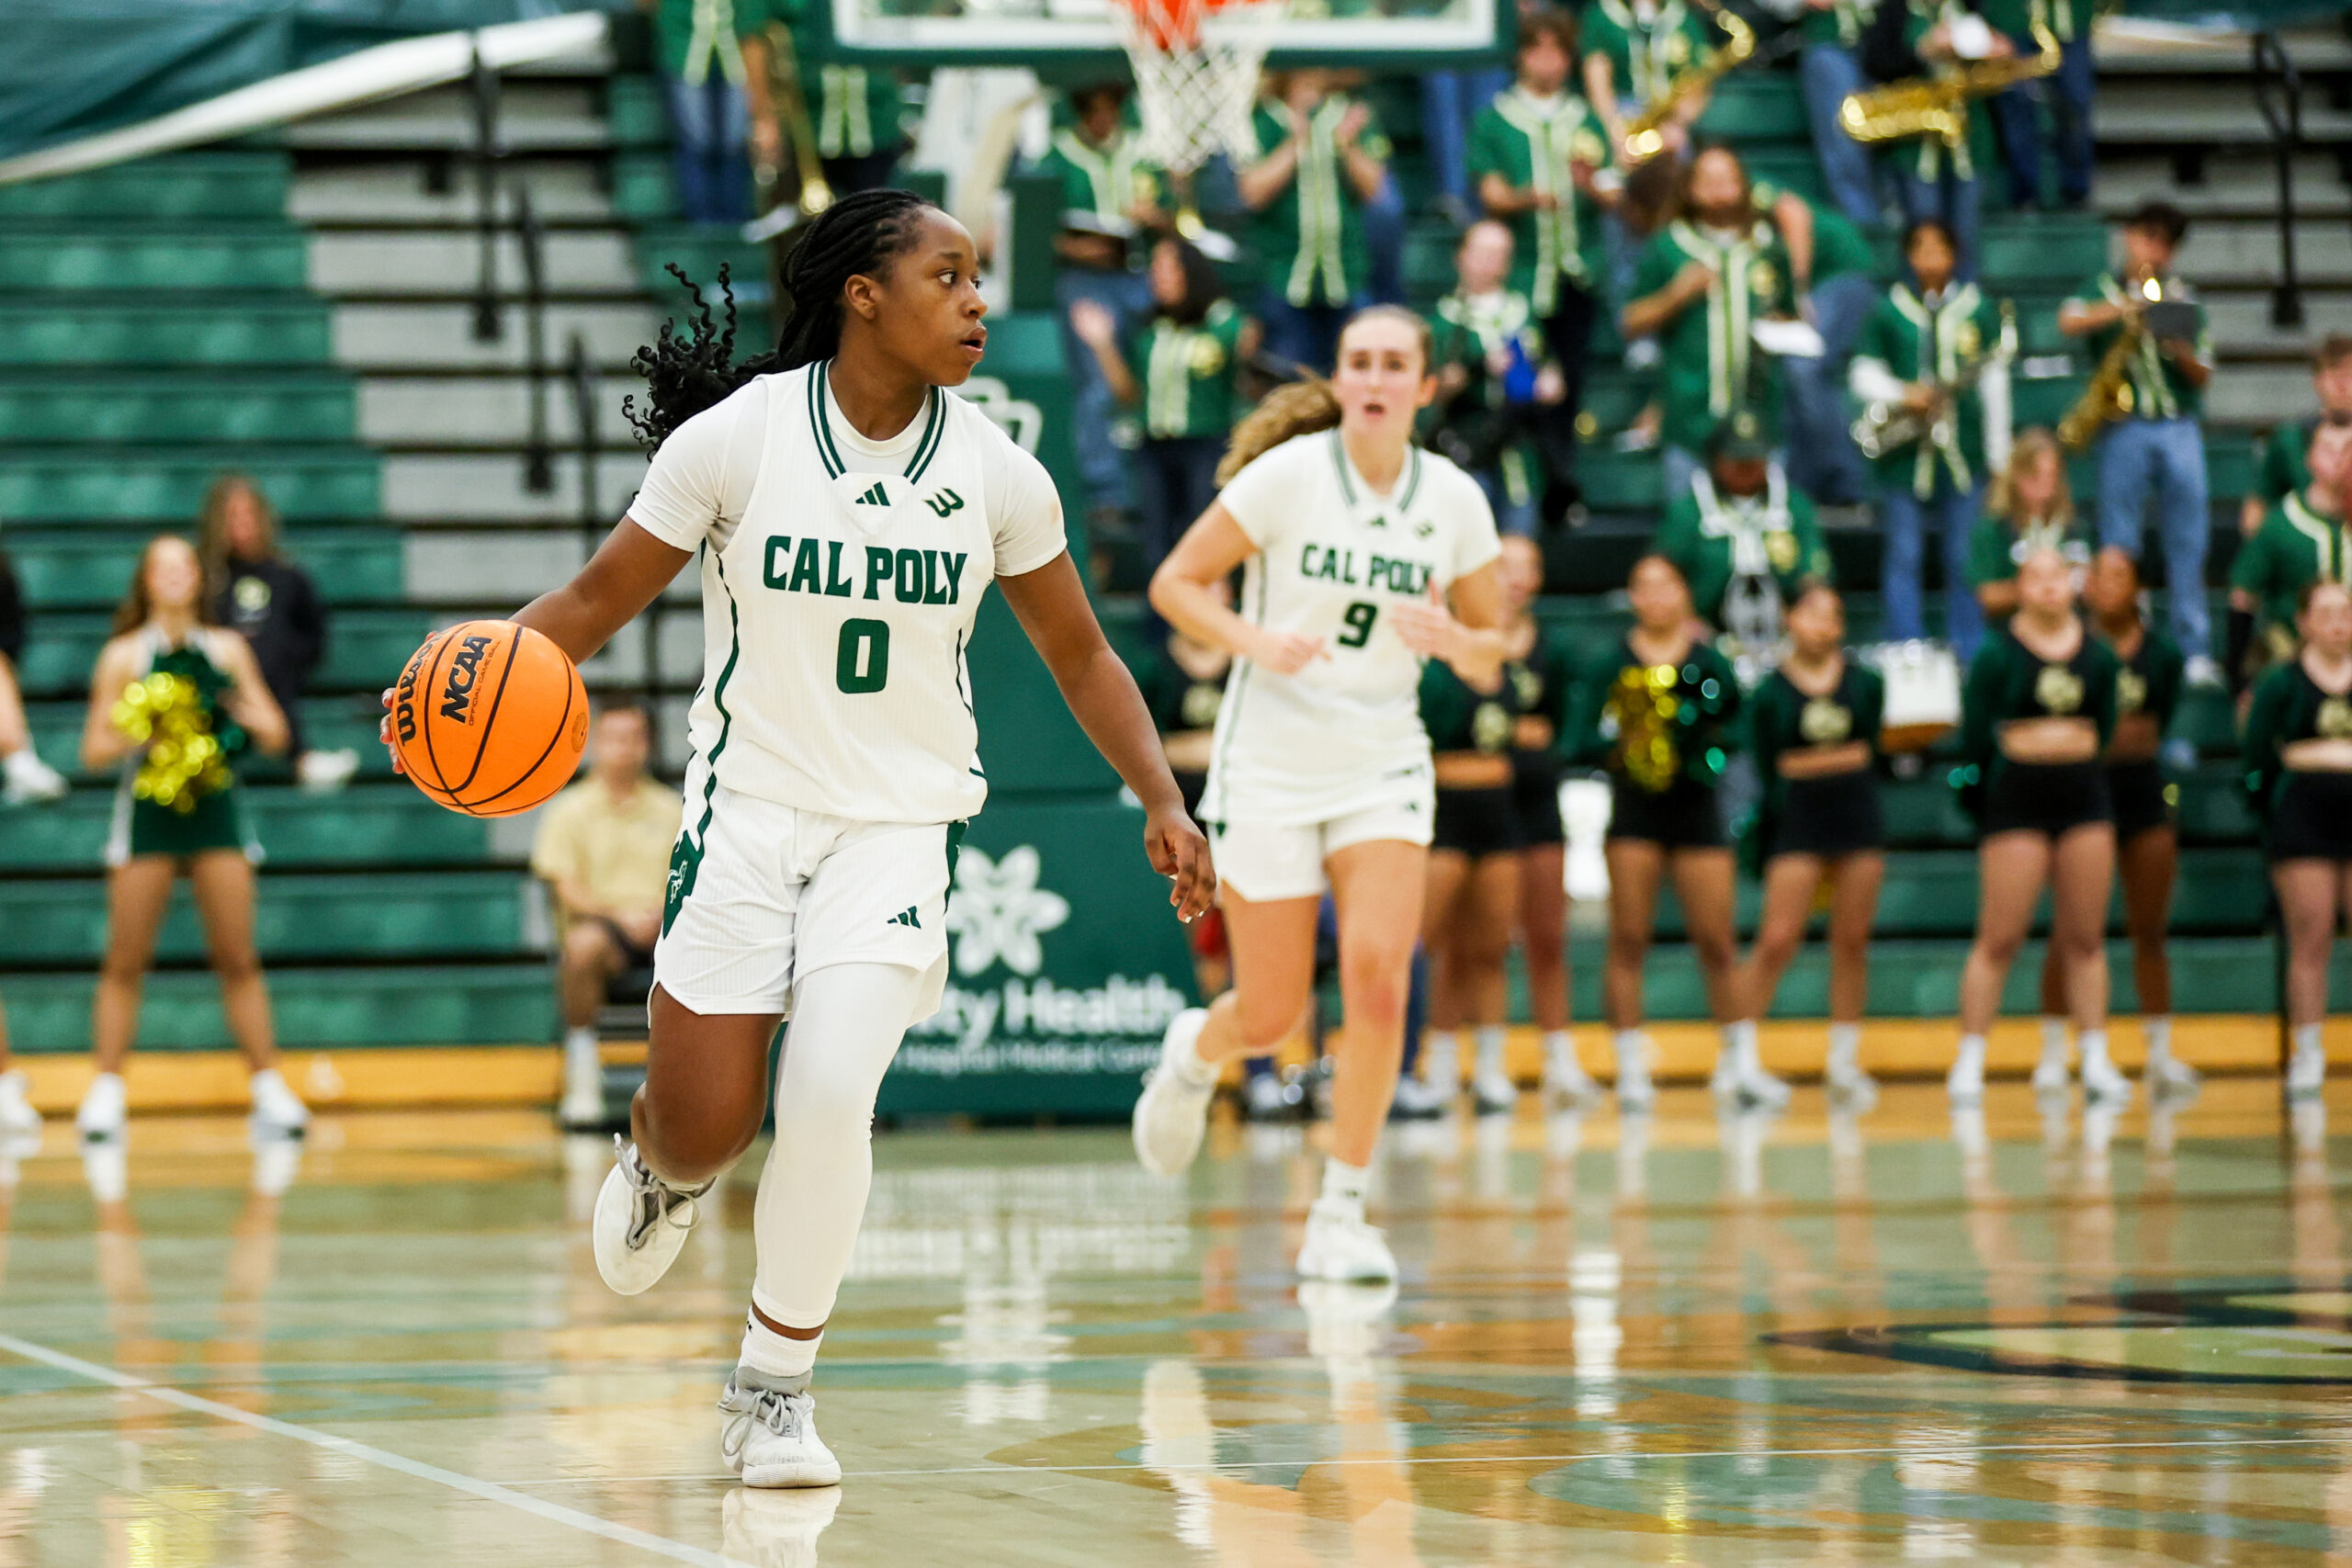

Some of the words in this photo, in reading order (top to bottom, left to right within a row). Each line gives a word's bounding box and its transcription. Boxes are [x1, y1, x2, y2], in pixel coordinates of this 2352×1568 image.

[763, 536, 853, 597] CAL
[863, 546, 967, 604] POLY
[1301, 544, 1356, 585] CAL
[836, 618, 889, 694] 0
[1338, 602, 1378, 649] 9
[440, 636, 492, 724] NCAA
[1003, 974, 1187, 1034] Health
